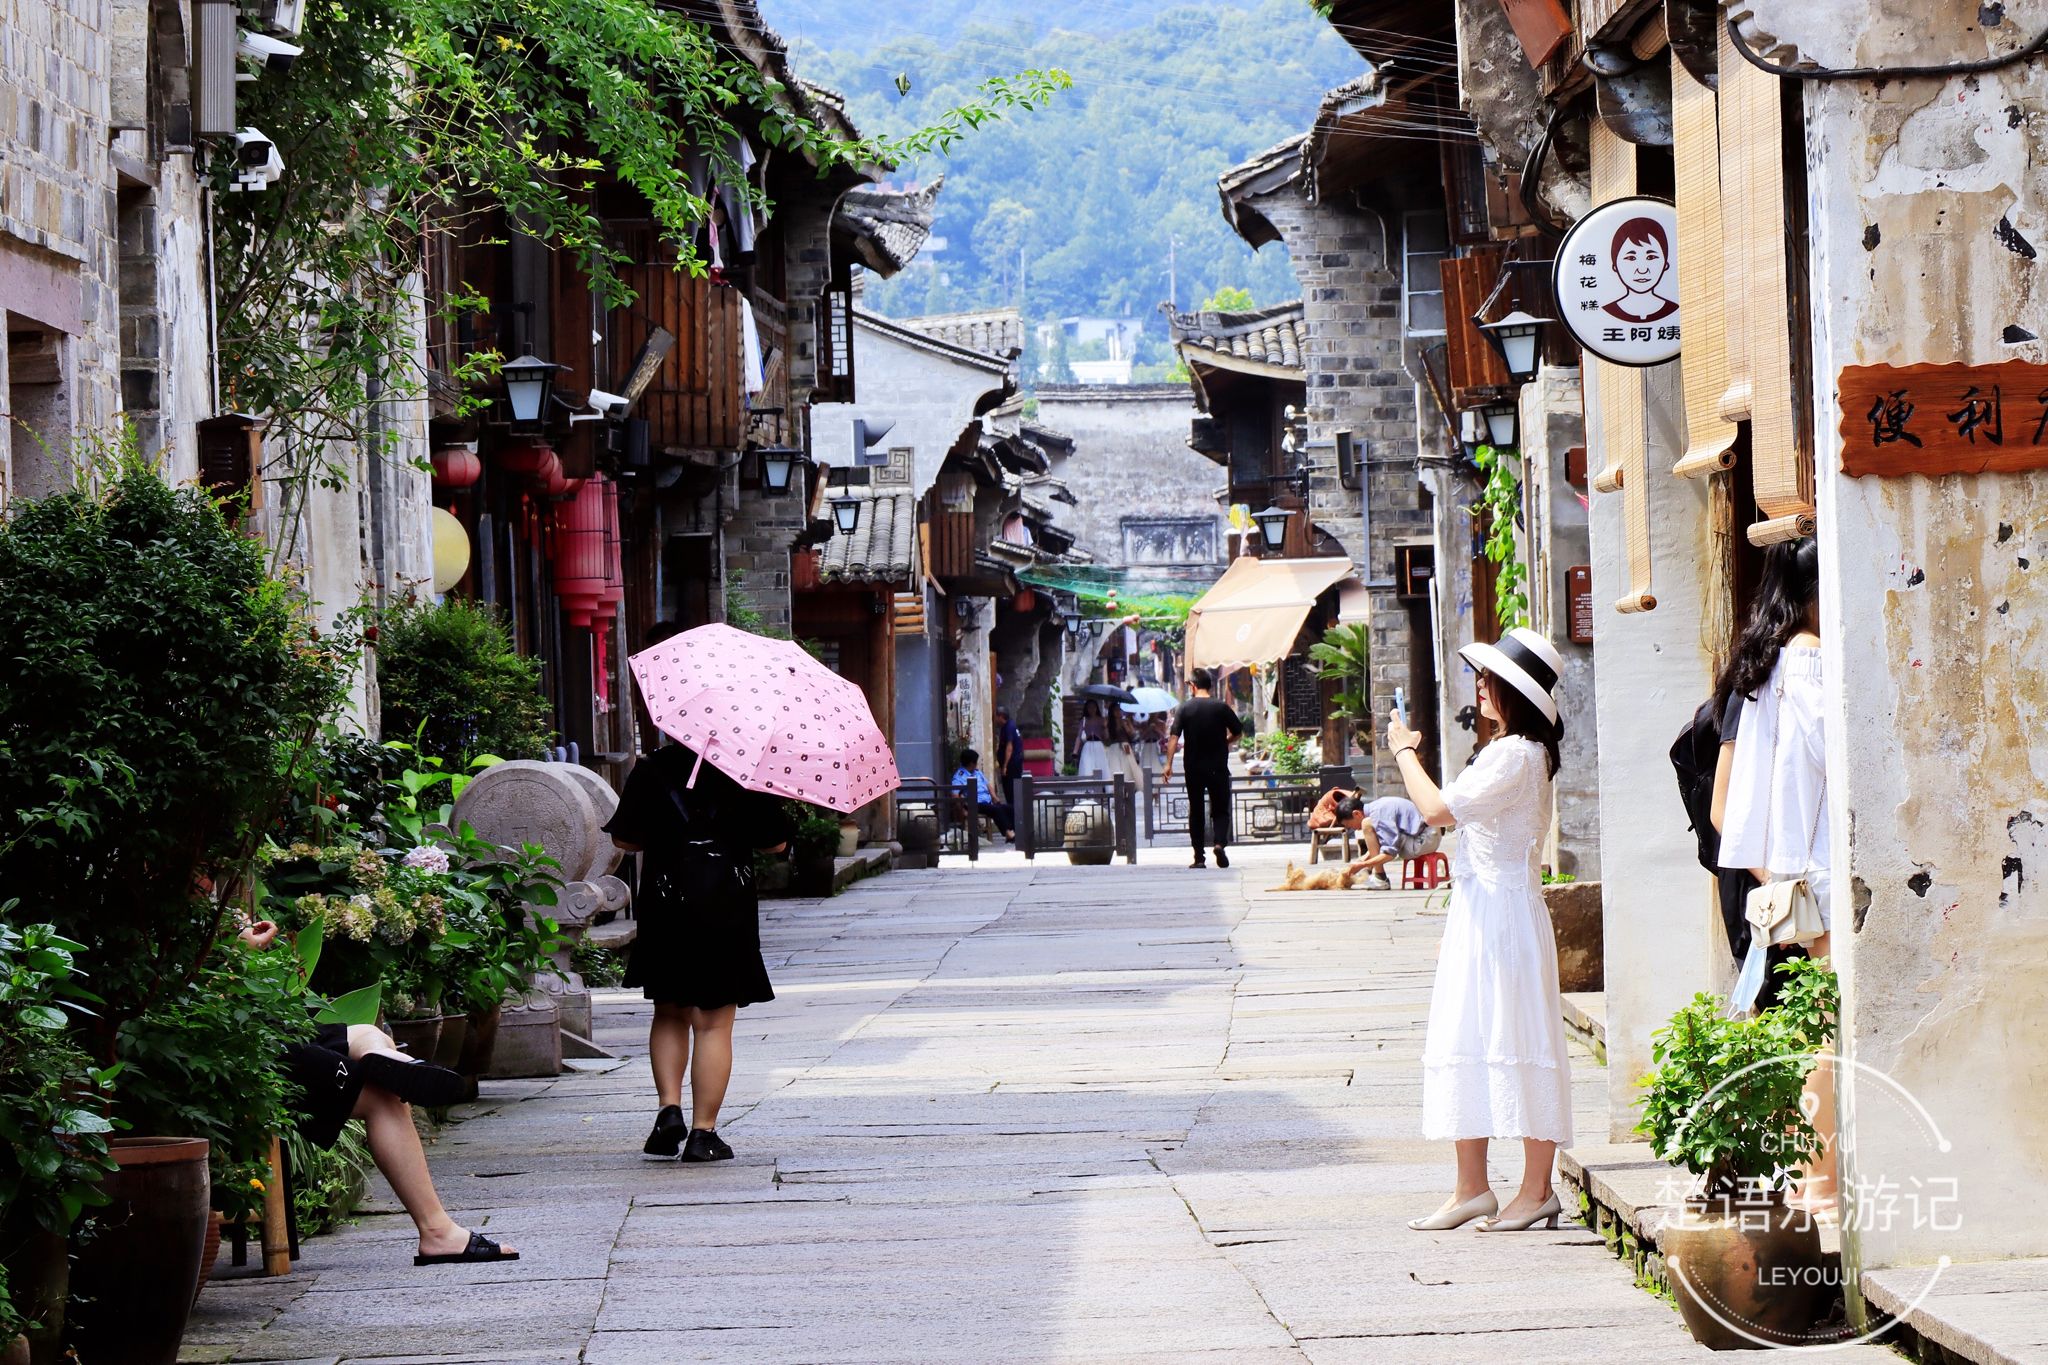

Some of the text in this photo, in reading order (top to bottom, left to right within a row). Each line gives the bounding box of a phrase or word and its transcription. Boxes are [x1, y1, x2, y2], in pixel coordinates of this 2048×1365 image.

[1579, 254, 1600, 311] 梅花糕
[1602, 325, 1681, 342] 王阿姨
